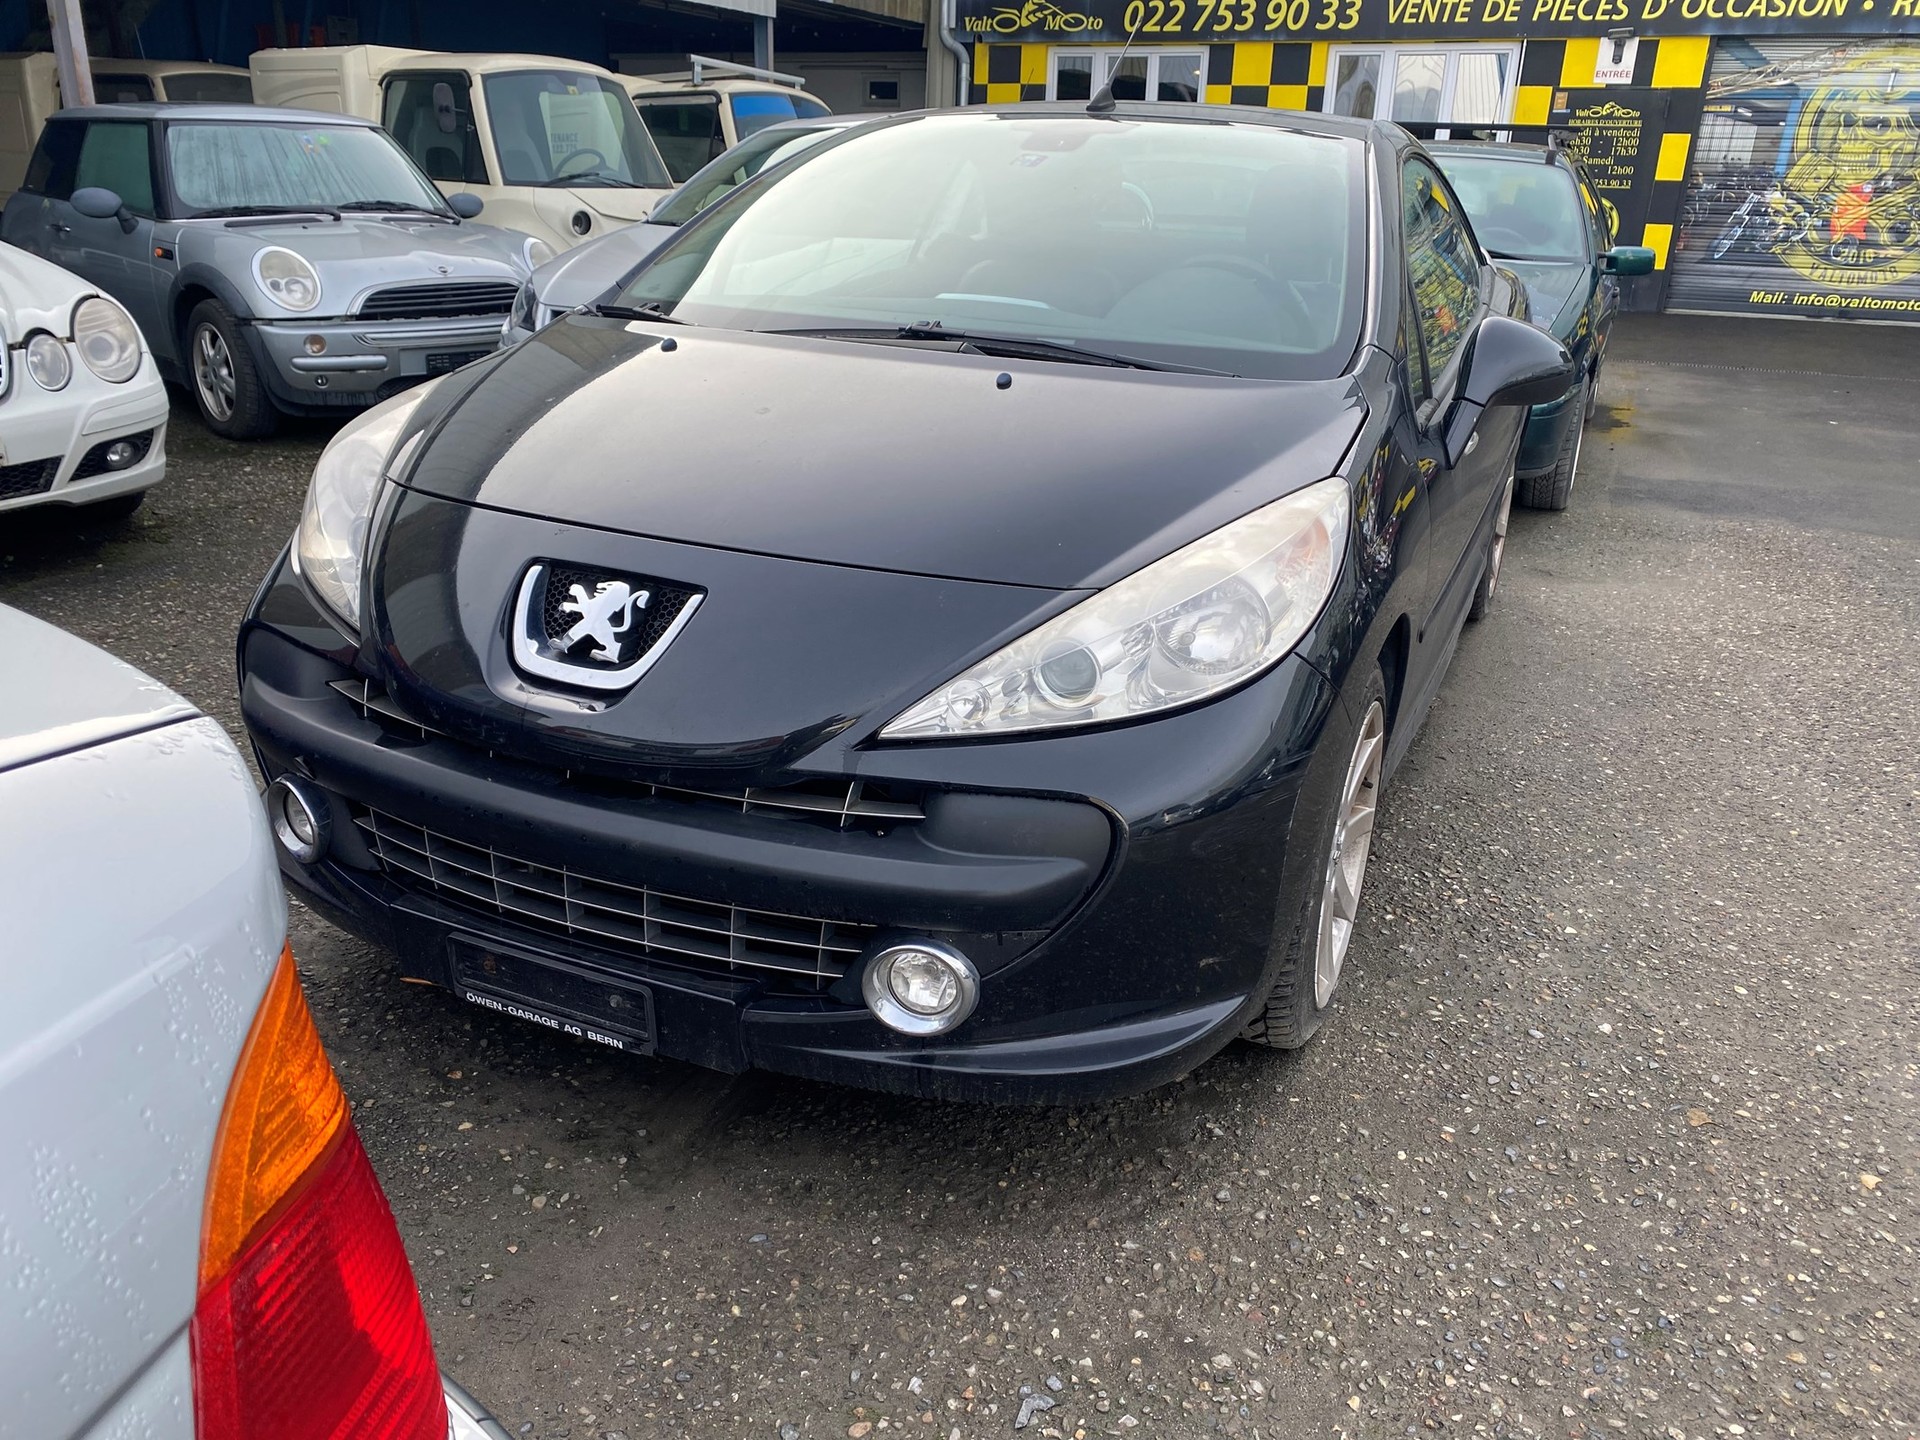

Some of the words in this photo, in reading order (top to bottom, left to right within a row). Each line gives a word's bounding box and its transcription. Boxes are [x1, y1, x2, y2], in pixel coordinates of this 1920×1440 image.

[1123, 0, 1186, 33] 022
[1192, 0, 1255, 32] 753
[1264, 0, 1310, 31] 90
[1315, 0, 1361, 30] 33
[1388, 0, 1473, 23] VENTE
[1482, 0, 1522, 22] DE
[1595, 69, 1631, 78] ENTRÉE
[1594, 127, 1600, 137] à
[1603, 128, 1640, 137] vendredi
[1613, 137, 1639, 146] 12h00
[1611, 146, 1638, 156] 17h30
[1583, 156, 1614, 165] Samedi
[1607, 166, 1634, 175] 12h00
[1610, 179, 1620, 188] 90
[1622, 179, 1632, 188] 33
[1749, 290, 1788, 304] Mail:
[465, 991, 560, 1030] ÖWEN-GARAGE
[563, 1023, 583, 1037] AG
[587, 1029, 624, 1050] BERN
